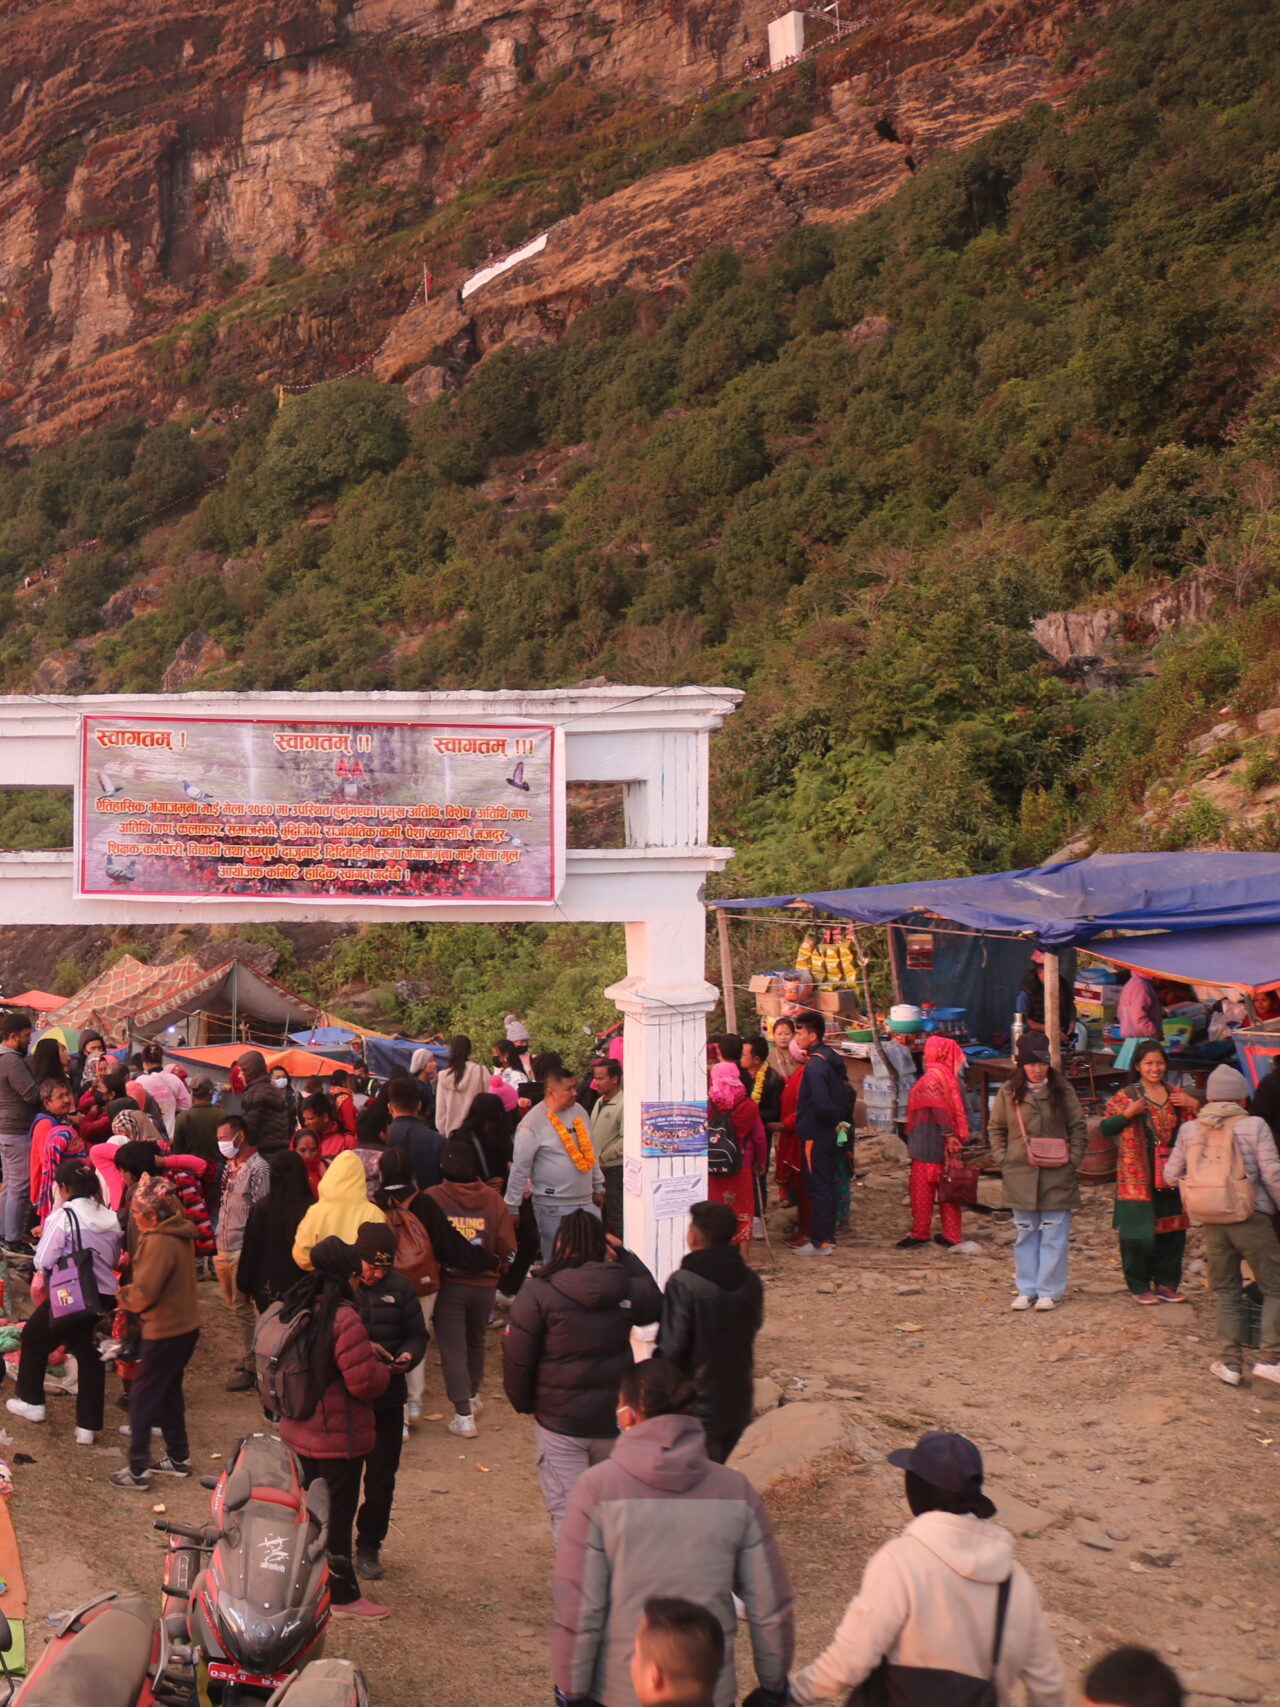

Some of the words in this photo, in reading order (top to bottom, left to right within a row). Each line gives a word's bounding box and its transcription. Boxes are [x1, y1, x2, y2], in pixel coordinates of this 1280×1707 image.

[95, 728, 174, 751] स्वागतम्
[273, 733, 352, 755] स्वागतम्
[432, 737, 509, 757] स्वागतम्
[447, 1216, 485, 1230] OLLING
